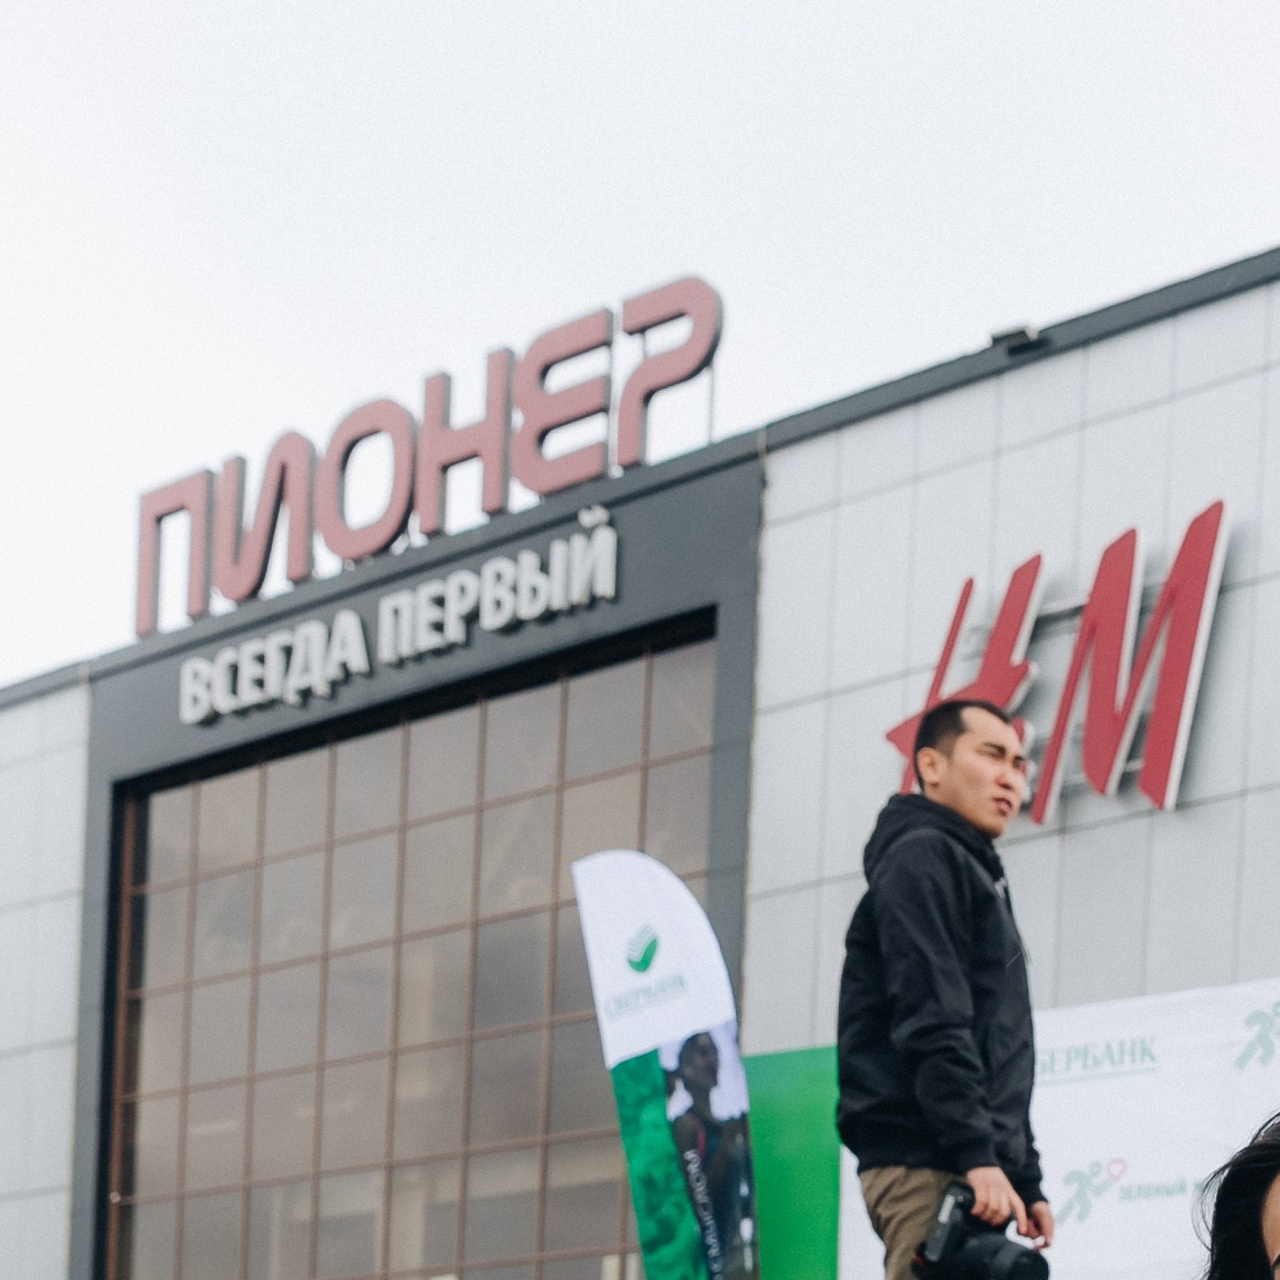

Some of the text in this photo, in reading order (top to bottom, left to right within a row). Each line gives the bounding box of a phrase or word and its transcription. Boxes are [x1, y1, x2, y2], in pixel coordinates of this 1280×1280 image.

[136, 276, 724, 640] ПИОНЕР
[179, 507, 619, 725] ВСЕГДА ПЕРВЫЙ
[885, 499, 1224, 826] HM
